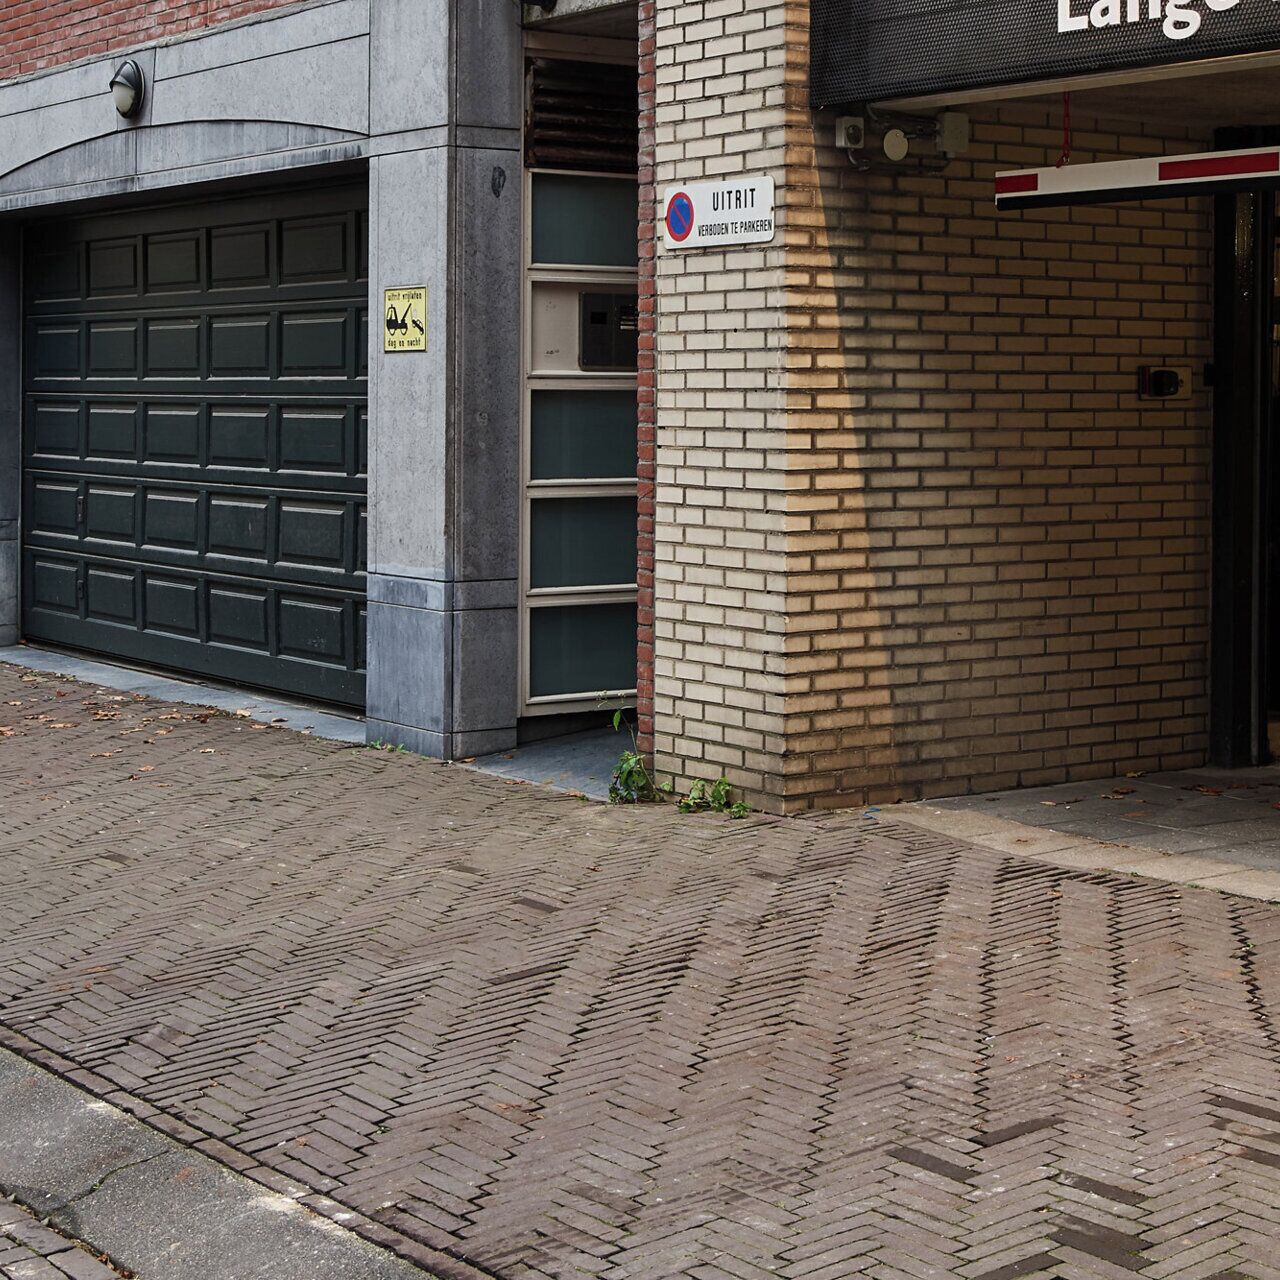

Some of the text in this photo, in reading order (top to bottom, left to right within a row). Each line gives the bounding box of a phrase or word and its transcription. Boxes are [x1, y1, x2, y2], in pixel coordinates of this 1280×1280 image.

[712, 187, 756, 211] UITRIT
[698, 218, 772, 237] VERBODEN TE PARKEREN
